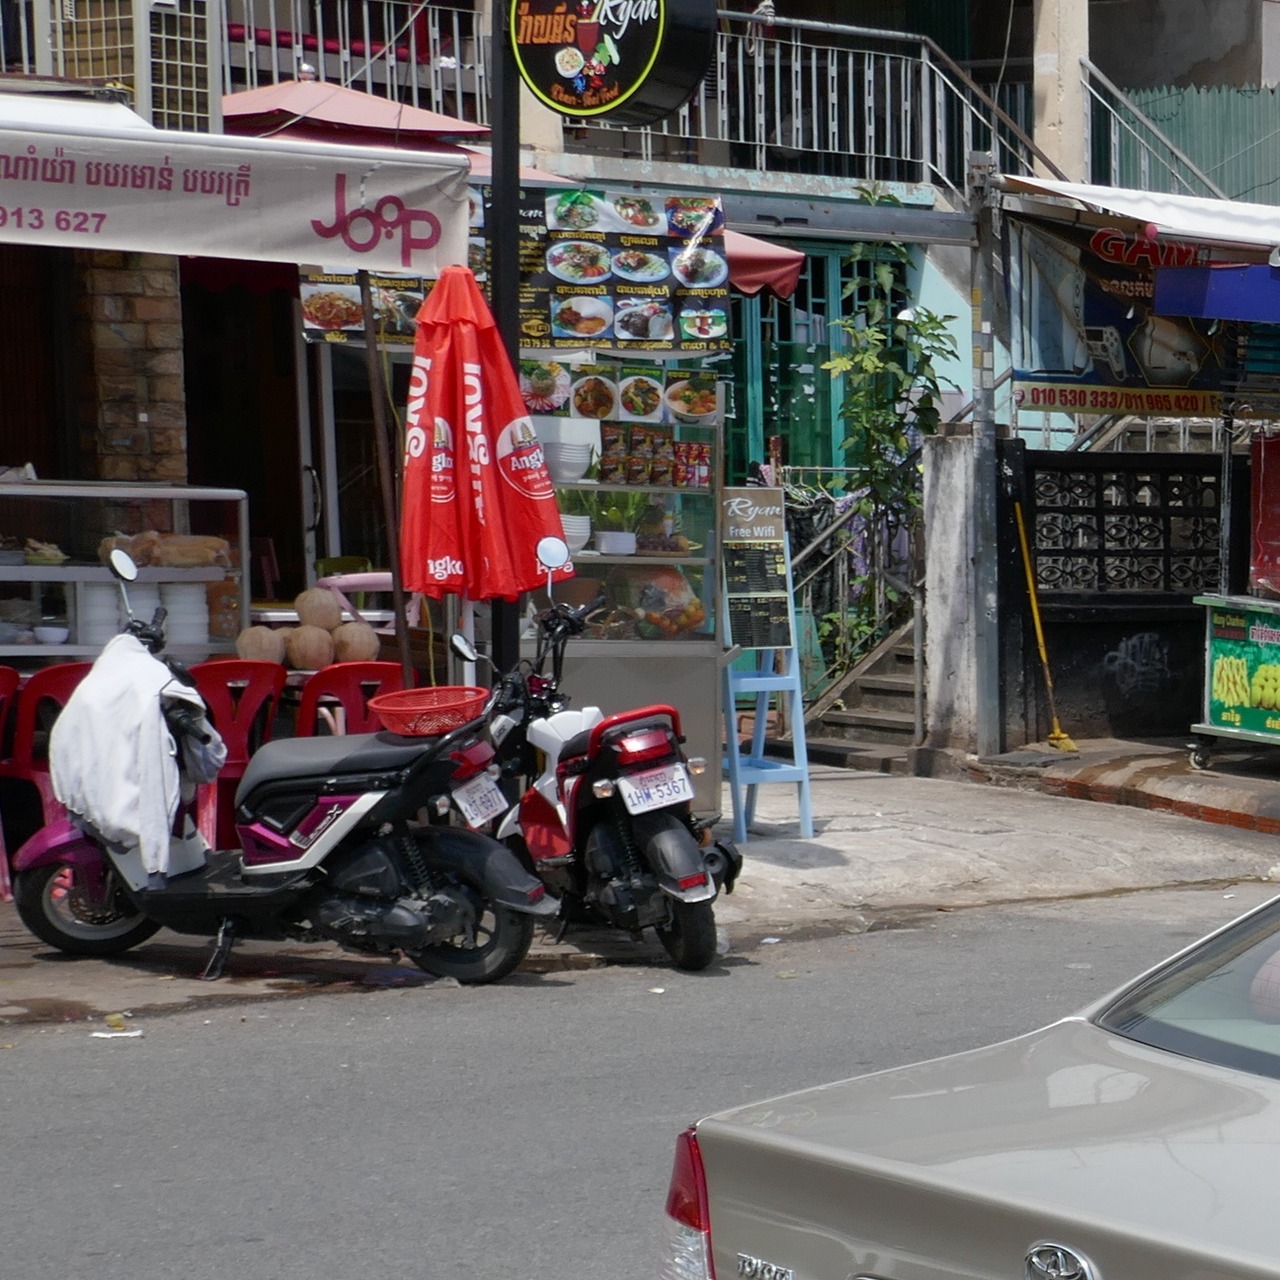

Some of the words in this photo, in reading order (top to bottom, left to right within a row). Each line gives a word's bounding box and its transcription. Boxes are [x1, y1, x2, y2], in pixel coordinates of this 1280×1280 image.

[55, 210, 107, 234] 627
[1090, 227, 1200, 266] GAM
[1031, 387, 1056, 405] 010
[1059, 389, 1087, 407] 530
[1150, 392, 1173, 411] 965
[1174, 394, 1199, 412] 420
[723, 497, 783, 522] Ryan
[729, 526, 751, 538] Free
[752, 525, 776, 538] Wifi
